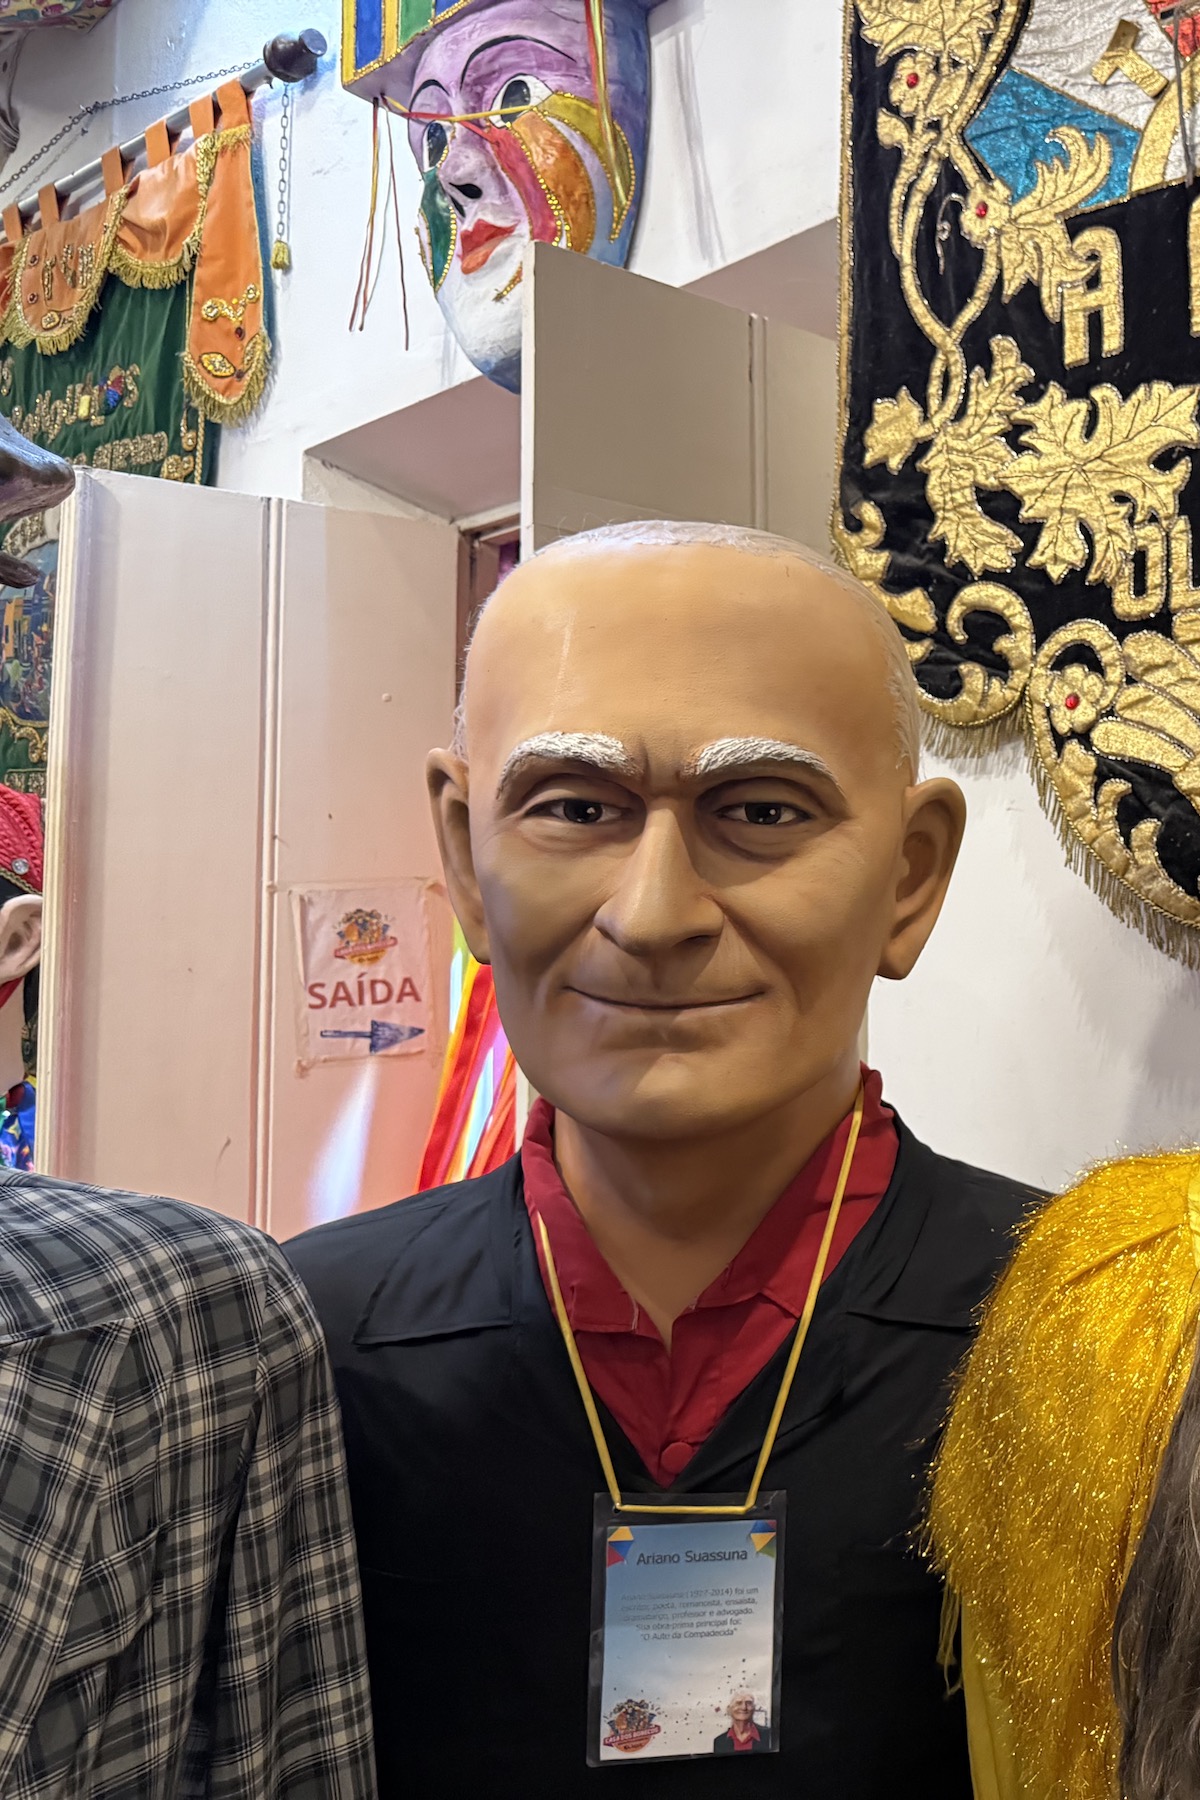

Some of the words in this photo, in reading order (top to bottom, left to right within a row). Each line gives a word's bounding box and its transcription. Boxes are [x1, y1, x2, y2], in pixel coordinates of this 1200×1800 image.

[1060, 226, 1126, 370] A
[308, 971, 423, 1010] SAÍDA
[636, 1552, 680, 1566] Ariano
[685, 1549, 748, 1563] Suassuna
[735, 1586, 744, 1595] foi
[746, 1587, 759, 1595] um
[672, 1610, 706, 1620] professor
[652, 1620, 694, 1630] obra-prima
[695, 1618, 728, 1628] principal
[672, 1630, 682, 1639] da
